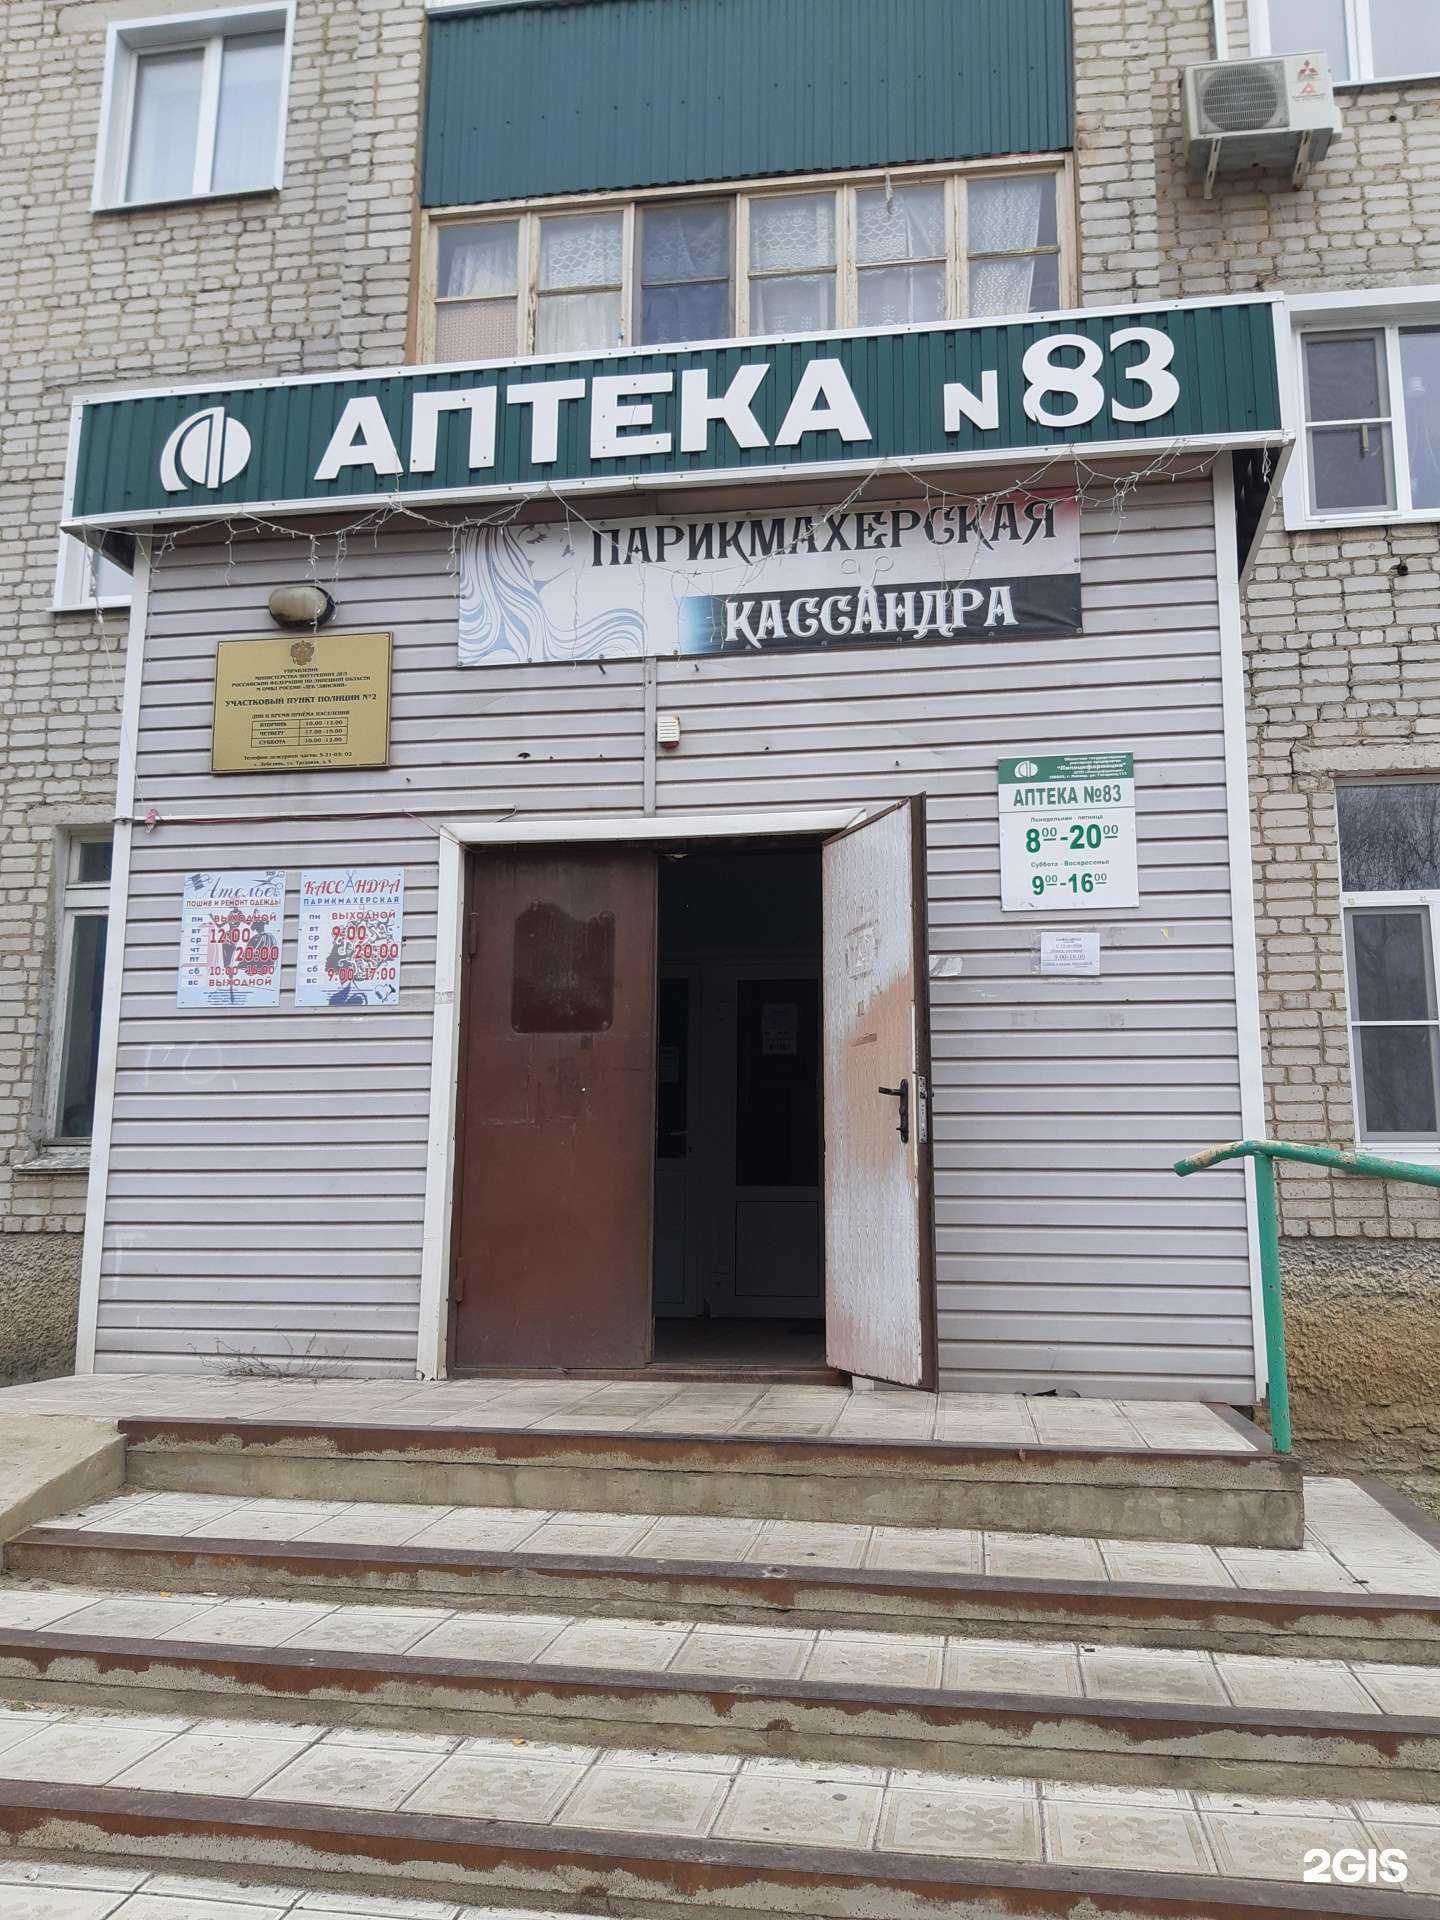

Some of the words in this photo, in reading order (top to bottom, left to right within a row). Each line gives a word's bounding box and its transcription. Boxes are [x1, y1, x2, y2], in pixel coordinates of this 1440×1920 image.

[315, 359, 871, 479] АПТЕКА
[1022, 328, 1180, 426] 83
[592, 500, 1057, 567] ПАРИКМАХЕРСКАЯ
[725, 586, 1020, 648] КАССАНДРА
[287, 696, 315, 704] ПУНКТ
[1013, 787, 1078, 806] АПТЕКА
[1084, 785, 1121, 803] №83
[1031, 861, 1058, 869] Суббота
[304, 879, 400, 896] КАССАНДРА
[304, 896, 399, 905] ПАРИКМАХЕРСКАЯ
[215, 913, 277, 924] ВЫХОДНОЙ
[331, 910, 396, 920] ВЫХОДНОЙ
[210, 928, 251, 944] 12:00
[332, 925, 366, 941] 9:00
[235, 947, 279, 961] 20:00
[354, 944, 399, 959] 20:00
[208, 976, 272, 986] ВЫХОДНОЙ
